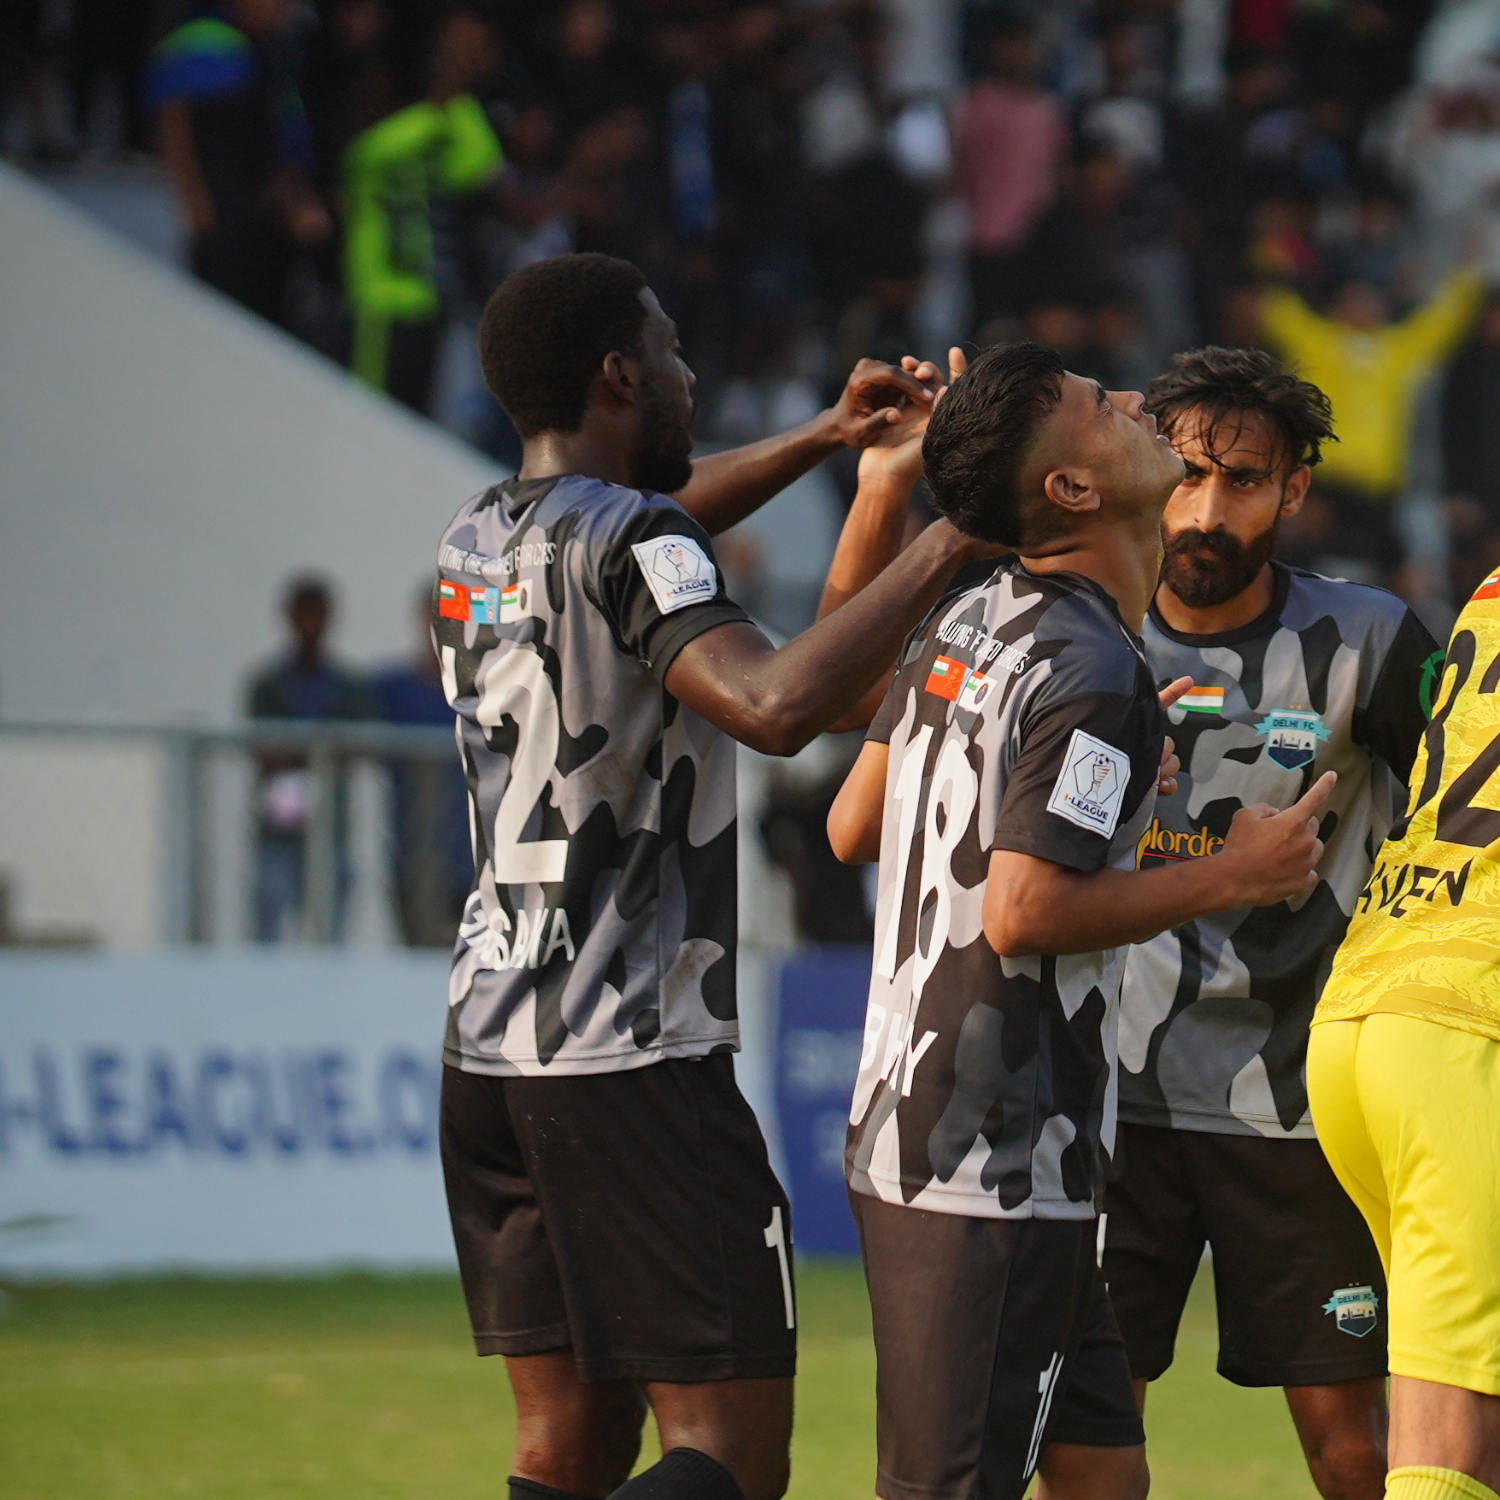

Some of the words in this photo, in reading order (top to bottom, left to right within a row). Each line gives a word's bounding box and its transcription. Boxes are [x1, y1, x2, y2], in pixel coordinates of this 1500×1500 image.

[1272, 719, 1299, 728] DELHI
[1303, 721, 1316, 731] FC
[1064, 793, 1110, 820] I-LEAGUE
[876, 723, 979, 1001] 18
[762, 1205, 795, 1330] 1
